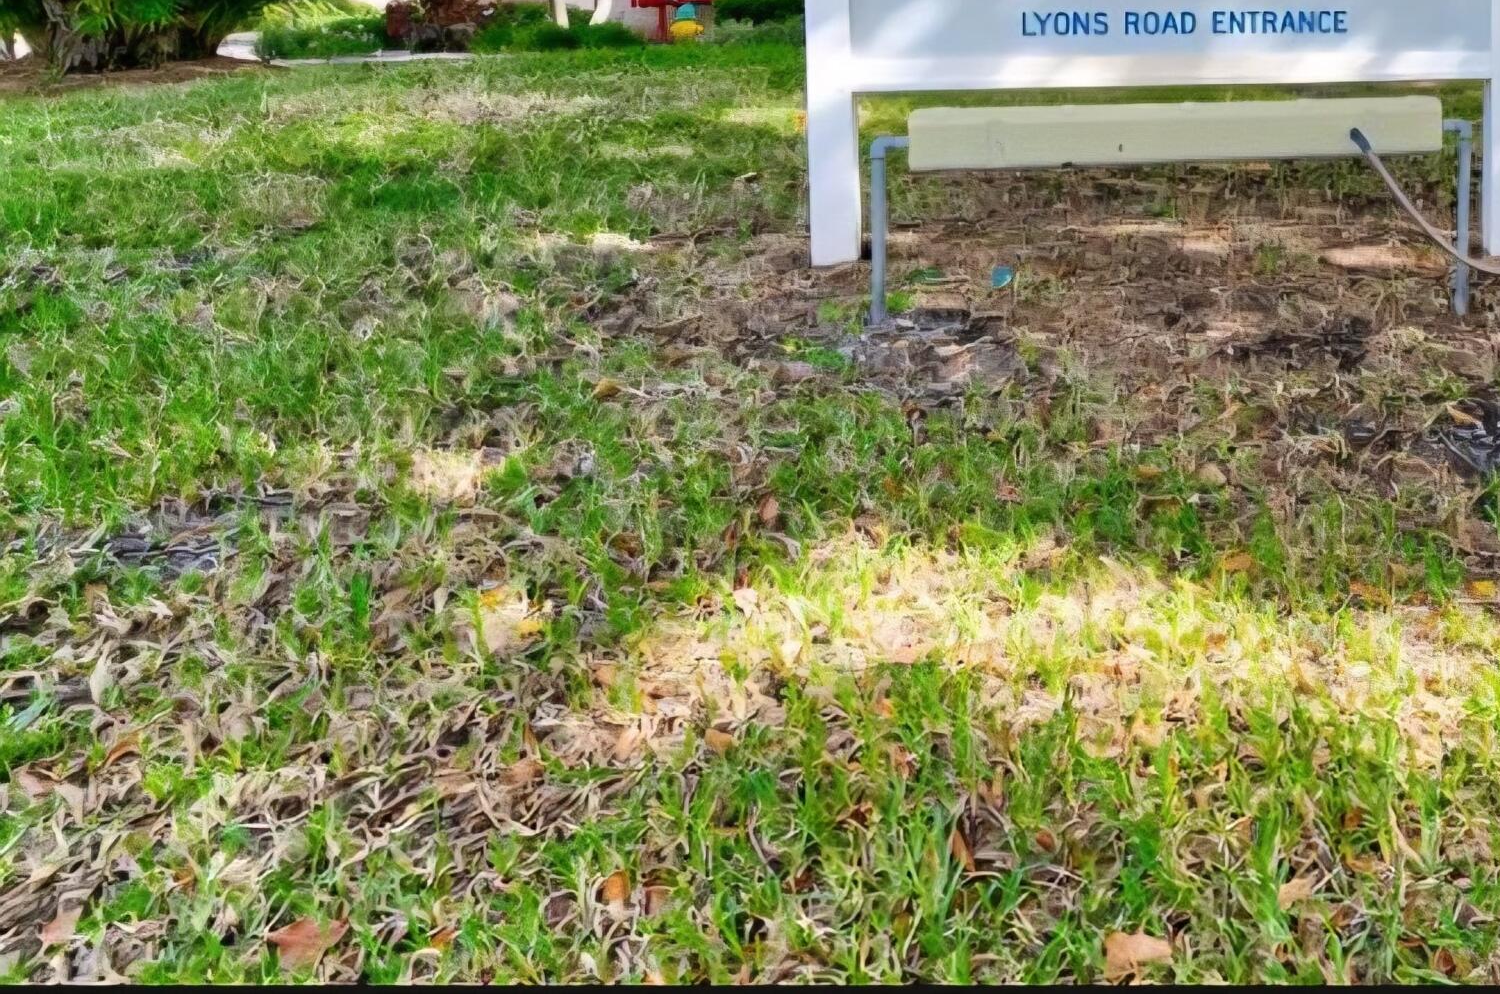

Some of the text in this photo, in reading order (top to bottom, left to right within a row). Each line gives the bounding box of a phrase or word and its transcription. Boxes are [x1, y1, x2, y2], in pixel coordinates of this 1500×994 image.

[1022, 10, 1348, 36] LYONS ROAD ENTRANCE
